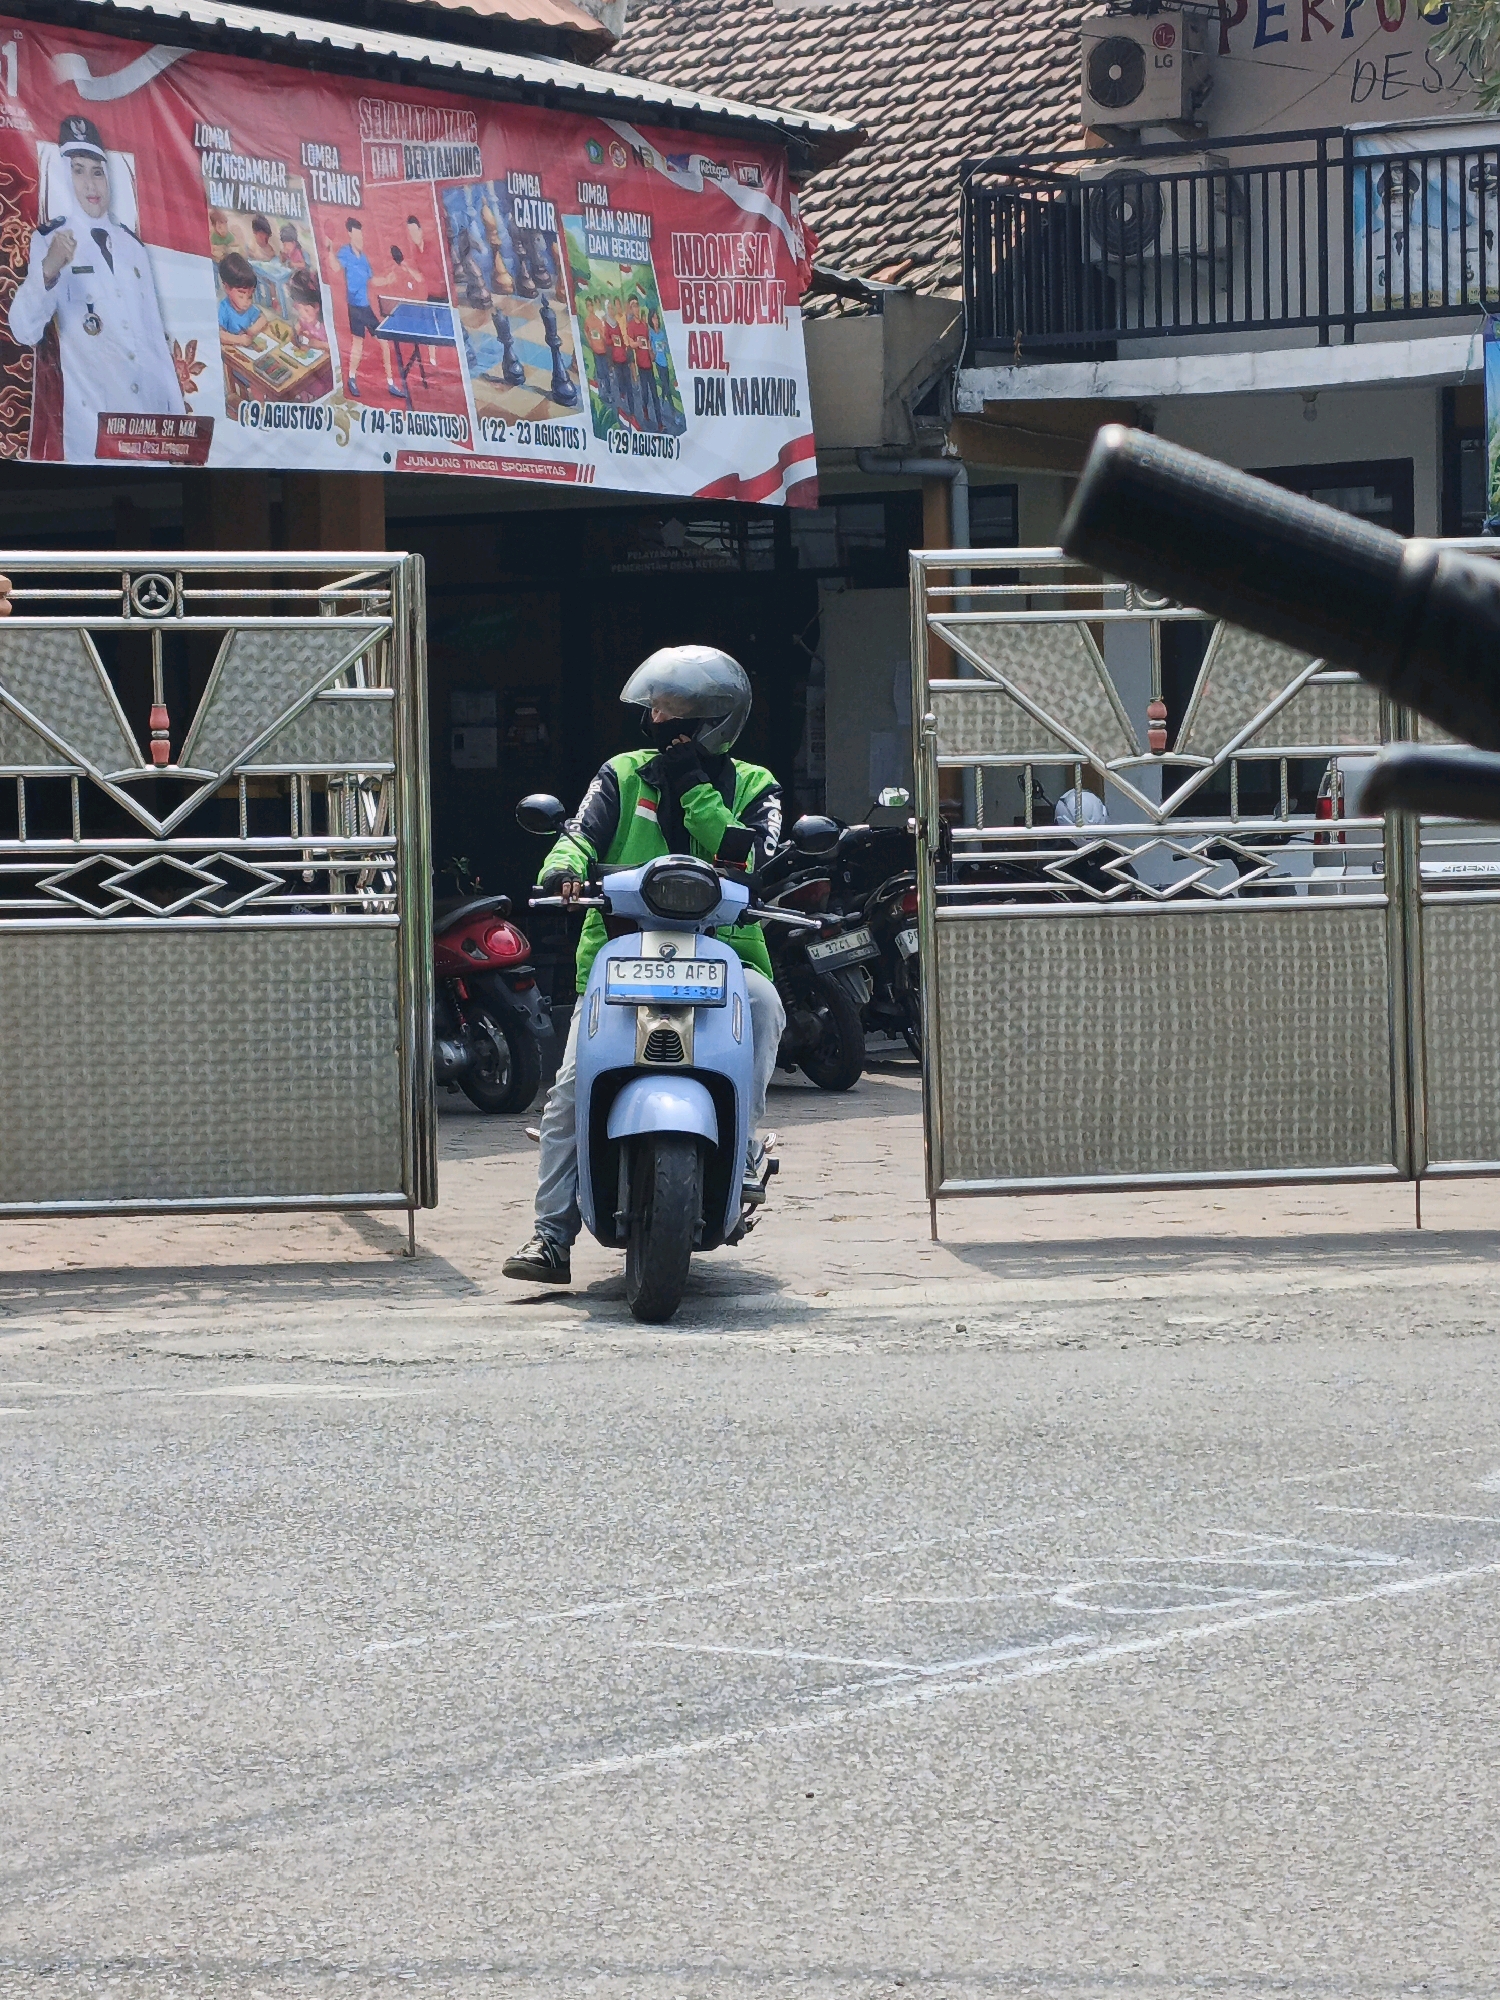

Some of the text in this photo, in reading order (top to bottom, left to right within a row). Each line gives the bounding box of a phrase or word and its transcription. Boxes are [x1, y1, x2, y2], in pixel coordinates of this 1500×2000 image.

[1155, 54, 1173, 68] LG
[195, 123, 231, 151] LOMBA
[201, 151, 287, 188] MENGGAMBAR
[302, 143, 339, 169] LOMBA
[370, 144, 481, 180] DAN BERTANDING
[209, 180, 302, 217] DAN MEWARNAI
[309, 169, 361, 206] TENNIS
[507, 171, 541, 198] LOMBA
[578, 182, 609, 206] LOMBA
[514, 197, 556, 232] CATUR
[585, 207, 651, 238] JALAN SANTAI
[588, 233, 649, 261] DAN BEREGU
[671, 232, 776, 279] INDONESIA
[679, 280, 788, 331] BERDAULAT,
[688, 331, 730, 376] ADIL,
[694, 377, 801, 418] DAN MAKMUR.
[107, 418, 126, 435] NUR
[403, 455, 566, 476] JUNJUNG TINGGI SPORTIFITAS
[614, 963, 718, 980] L 2558 AFB
